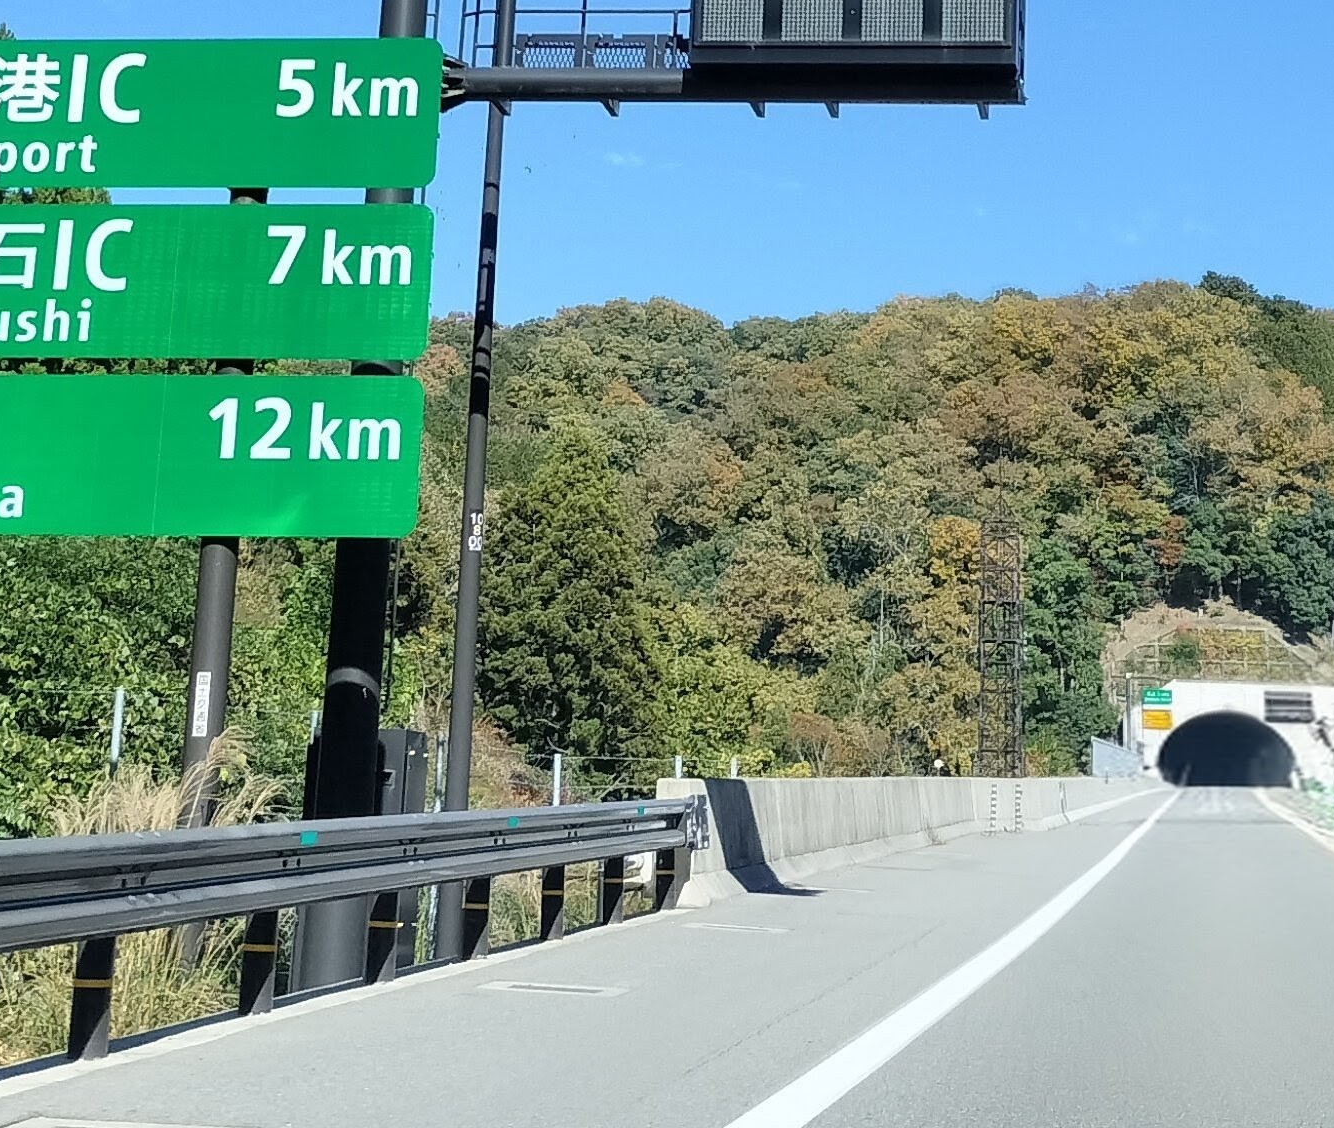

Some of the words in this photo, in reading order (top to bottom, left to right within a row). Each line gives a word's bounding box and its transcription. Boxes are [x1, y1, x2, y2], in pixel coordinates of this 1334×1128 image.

[277, 60, 315, 117] 5
[332, 63, 418, 115] km
[268, 226, 305, 284] 7
[322, 230, 411, 284] km
[210, 398, 291, 458] 12
[309, 403, 400, 459] km
[473, 524, 481, 536] 8
